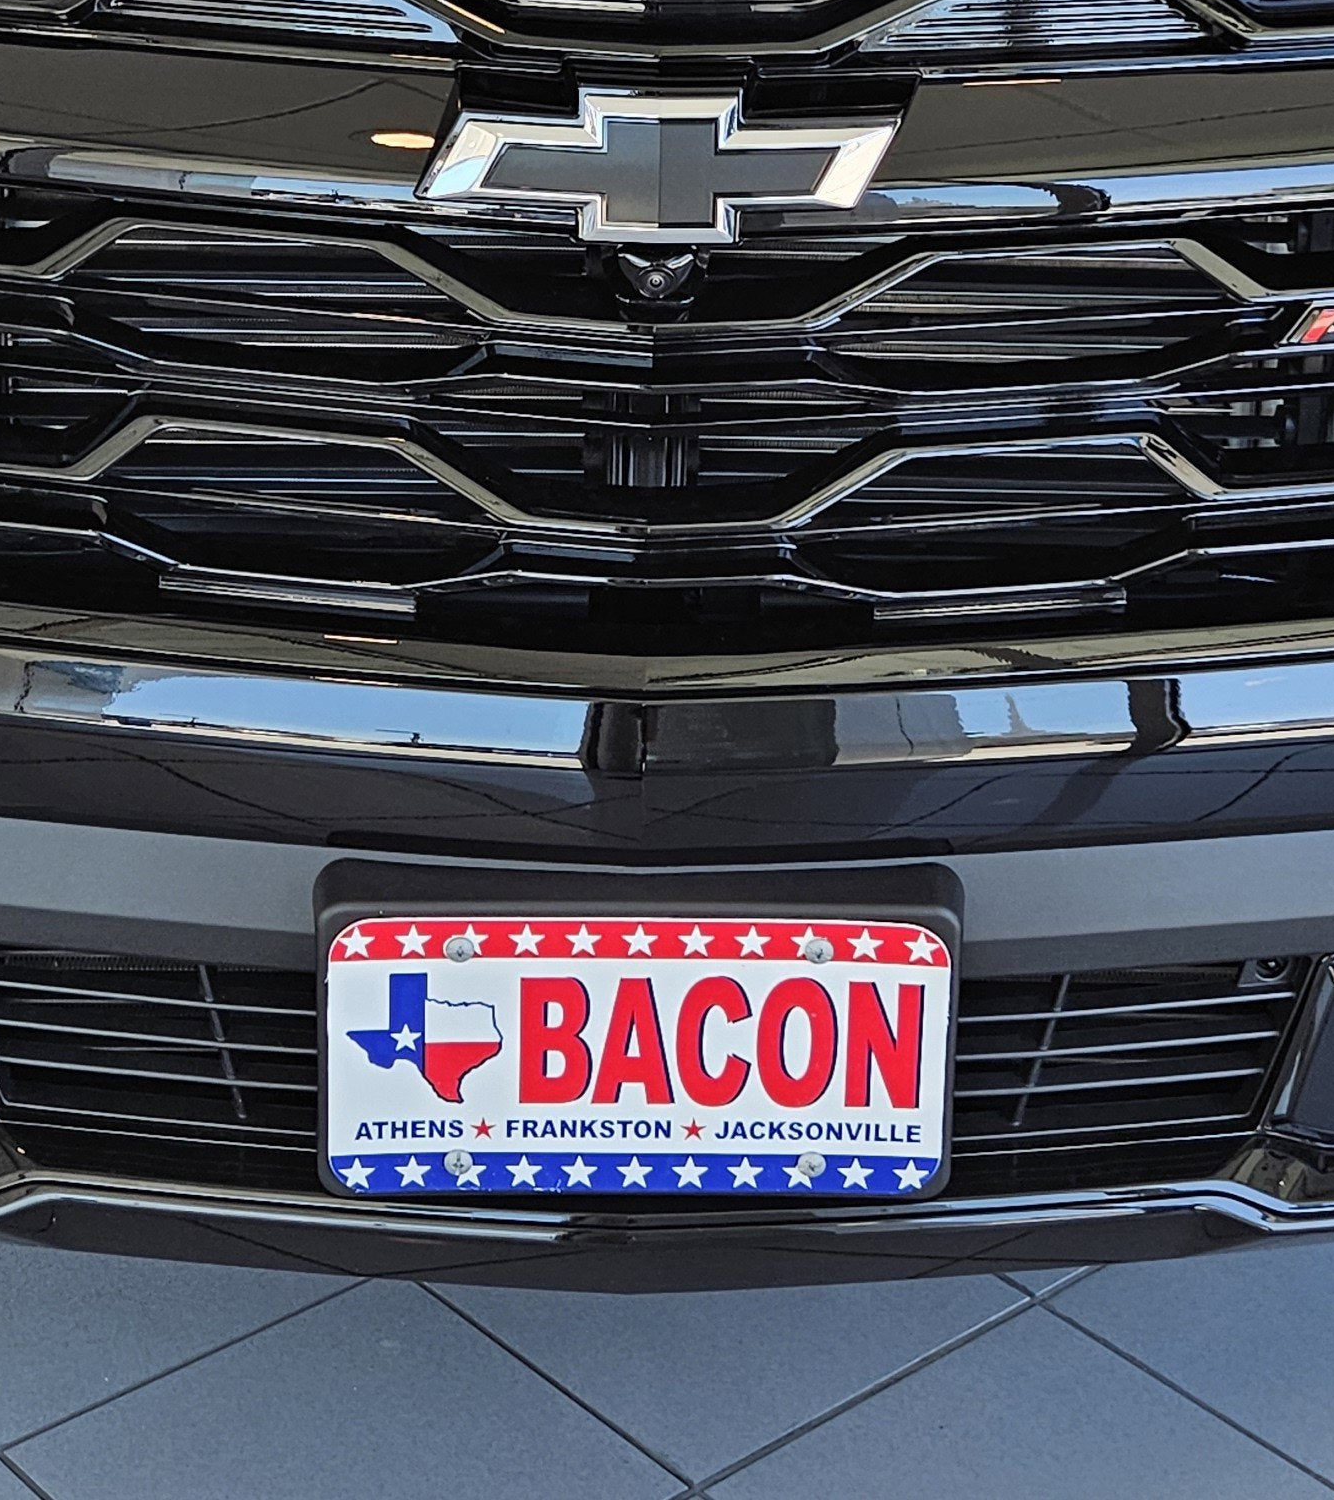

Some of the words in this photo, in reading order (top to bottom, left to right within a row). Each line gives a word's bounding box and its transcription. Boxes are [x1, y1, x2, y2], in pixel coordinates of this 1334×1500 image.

[519, 976, 926, 1109] BACON
[354, 1119, 465, 1141] ATHENS
[505, 1119, 672, 1140] FRANKSTON
[714, 1120, 922, 1144] JACKSONVILLE
